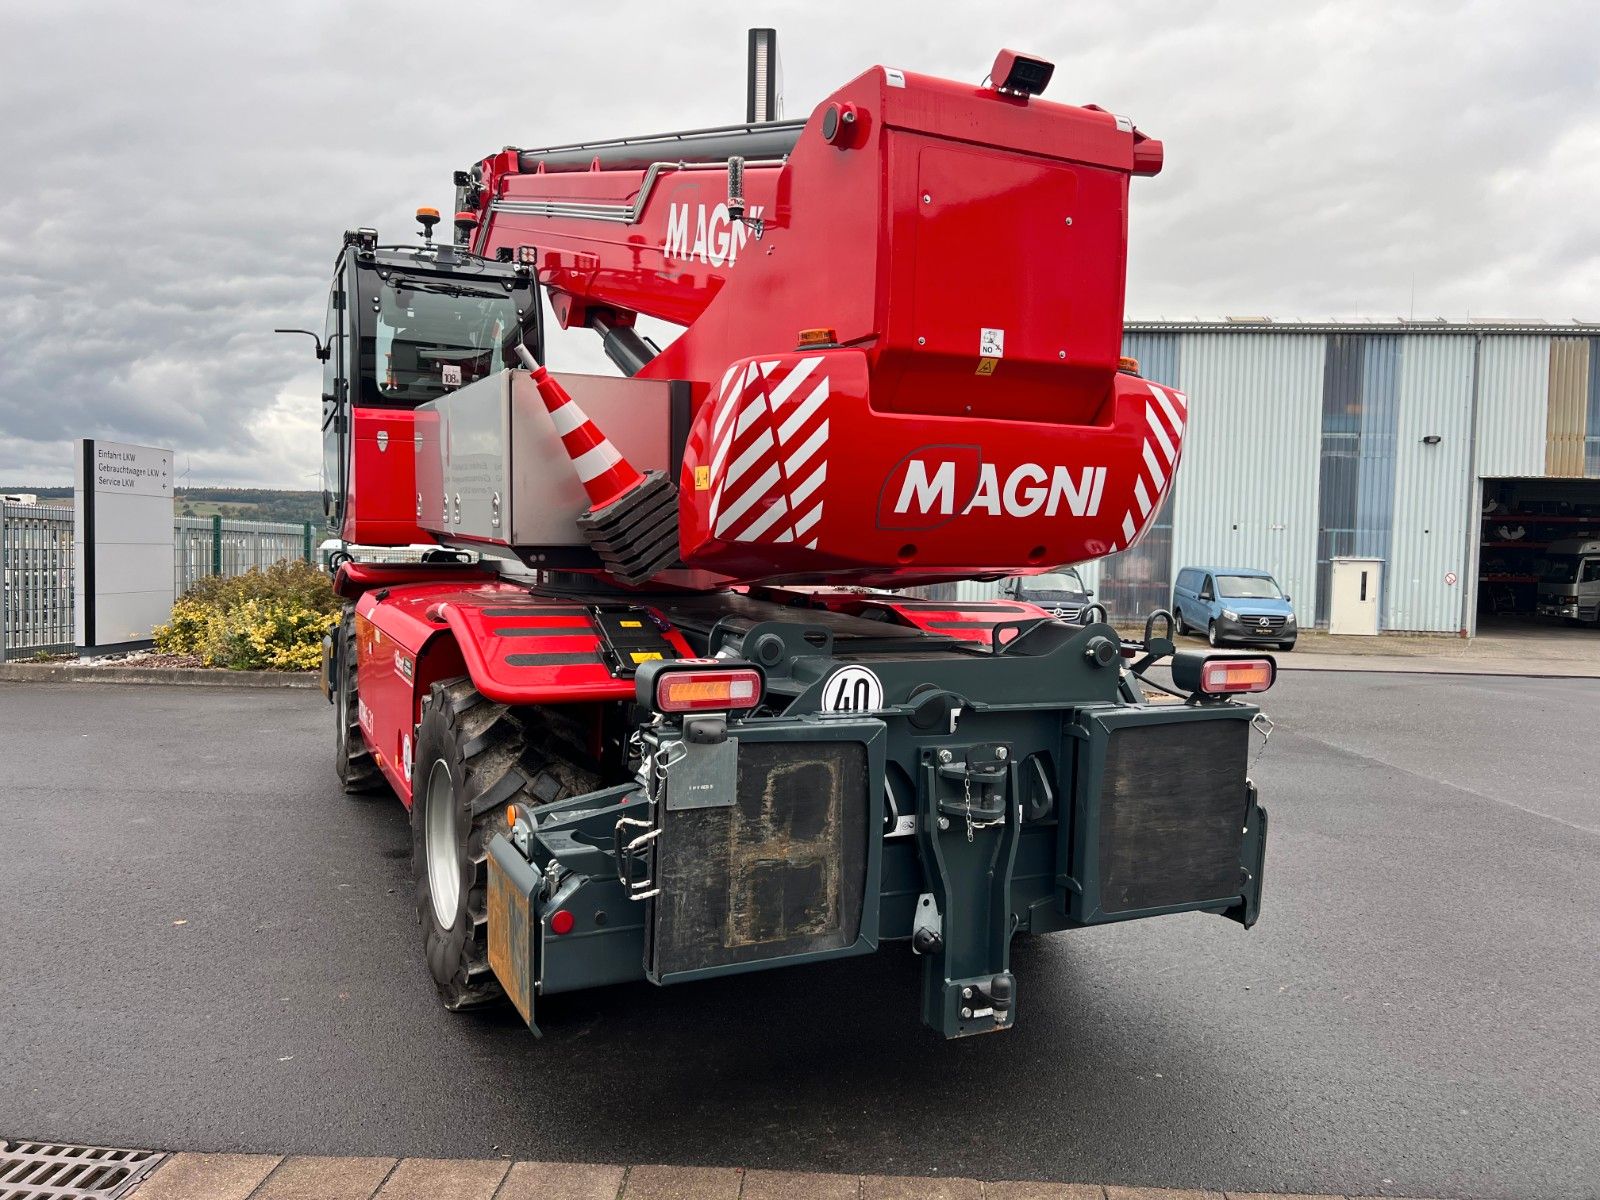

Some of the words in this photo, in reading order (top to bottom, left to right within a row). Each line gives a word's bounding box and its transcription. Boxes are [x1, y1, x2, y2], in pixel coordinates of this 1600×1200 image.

[444, 373, 456, 384] 108
[98, 449, 122, 460] Einfahrt
[122, 453, 136, 462] LKW
[98, 462, 146, 477] Gebrauchtwagen
[146, 468, 160, 478] LKW
[98, 476, 121, 486] Service
[121, 479, 135, 487] LKW
[893, 459, 1107, 518] MAGNI
[833, 678, 870, 711] 40
